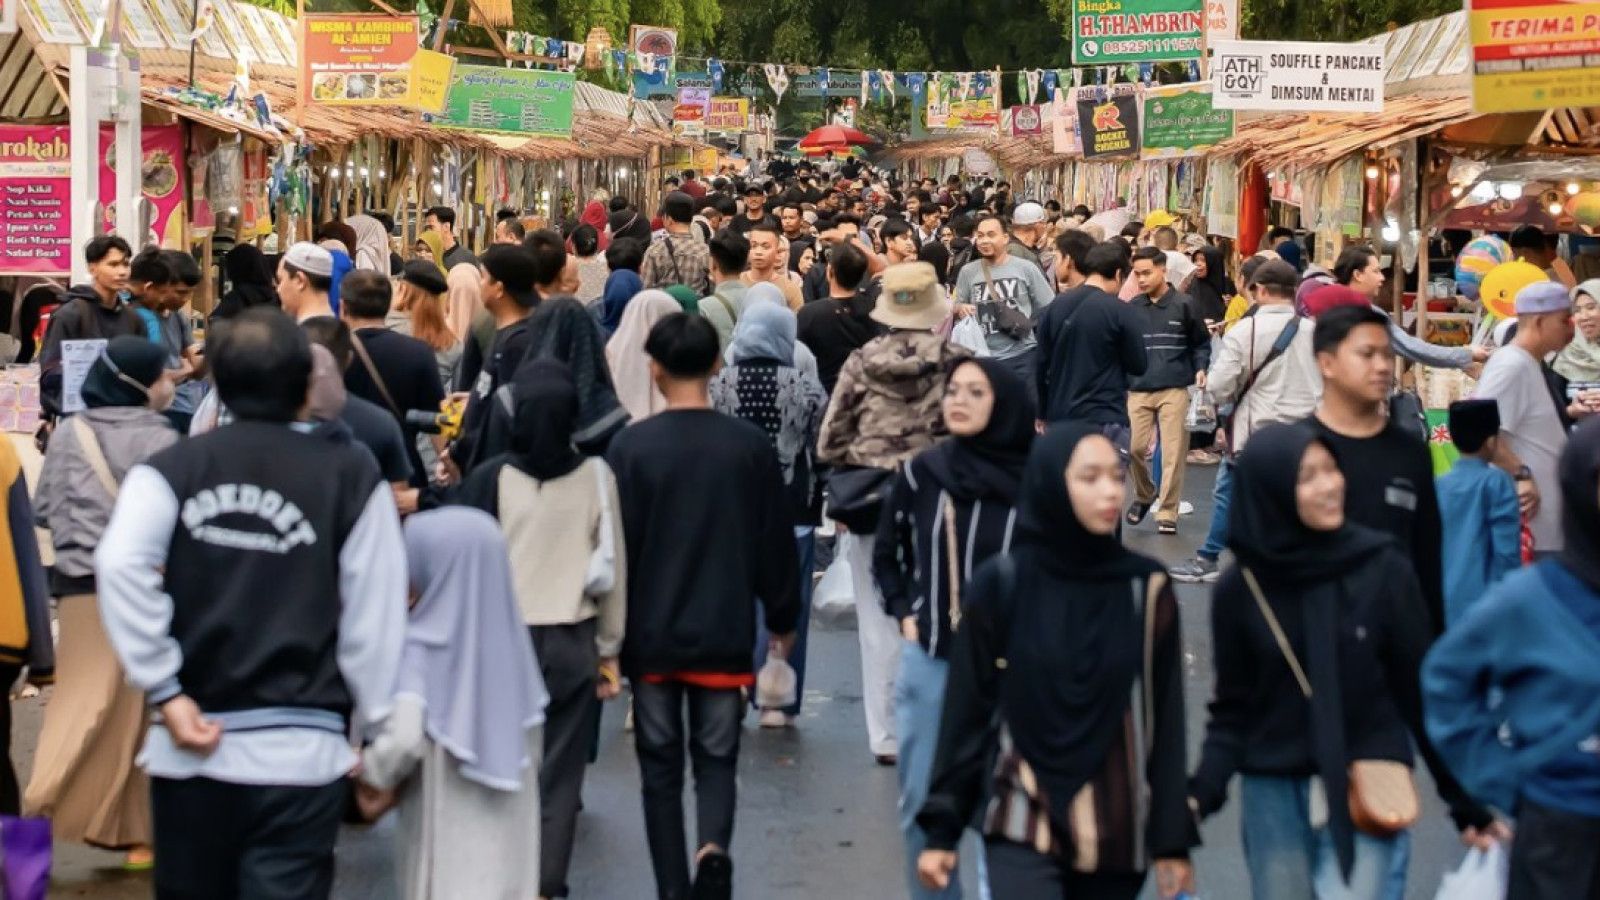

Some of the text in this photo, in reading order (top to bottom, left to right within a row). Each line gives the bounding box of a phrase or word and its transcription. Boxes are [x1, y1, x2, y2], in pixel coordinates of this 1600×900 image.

[1079, 0, 1121, 13] Bingka
[310, 21, 413, 32] WISMA KAMBING
[1490, 15, 1574, 38] TERIMA
[331, 33, 391, 44] AL-AMIEN
[1225, 57, 1260, 73] ATH
[1270, 53, 1381, 71] SOUFFLE PANCAKE
[675, 78, 713, 88] Salama
[1224, 74, 1259, 90] &QY
[1321, 72, 1329, 85] &
[1271, 85, 1375, 102] DIMSUM MENTAI
[1095, 131, 1128, 142] ROCKET
[1094, 140, 1131, 153] CHICKEN
[6, 184, 52, 194] Sop Kikil
[6, 198, 28, 206] Nasi
[37, 210, 62, 219] Arab
[32, 223, 57, 231] Arab
[6, 236, 27, 244] Roti
[6, 249, 33, 257] Salad
